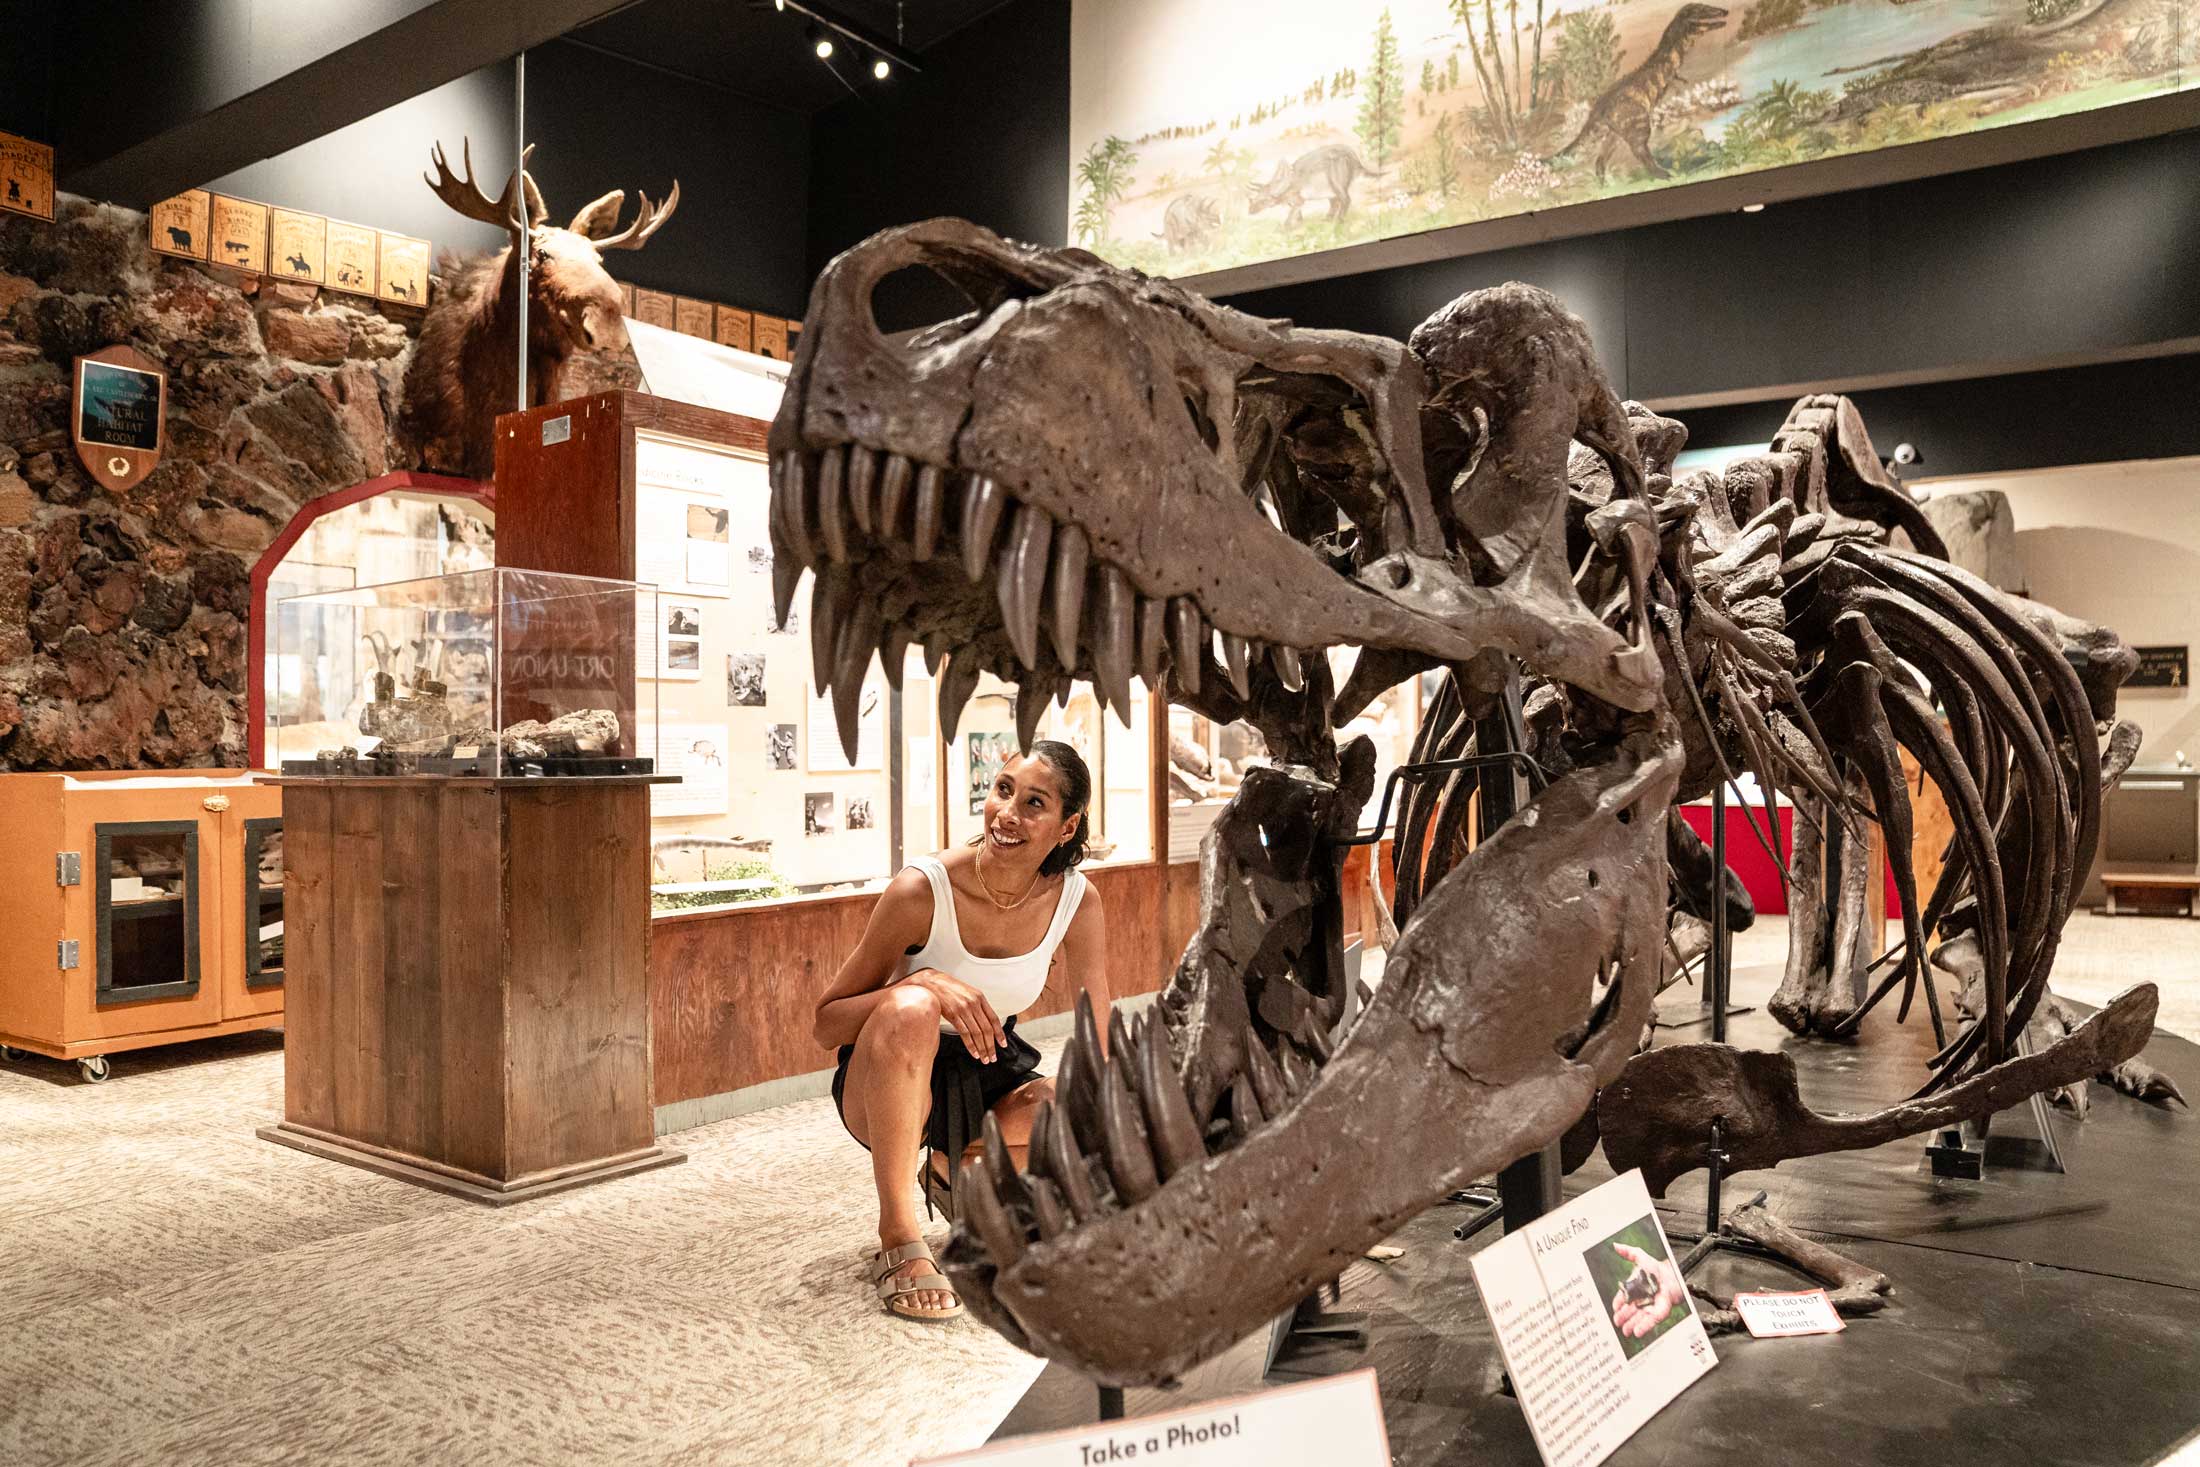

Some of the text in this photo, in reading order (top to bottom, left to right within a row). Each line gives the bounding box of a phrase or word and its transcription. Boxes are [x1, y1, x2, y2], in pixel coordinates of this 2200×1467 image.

[97, 416, 144, 433] HABITAT
[104, 430, 136, 444] ROOM
[1536, 1217, 1589, 1256] A UNIQUE FIND
[1743, 1295, 1821, 1307] PLEASE DO NOT
[1770, 1309, 1806, 1318] TOUCH
[1771, 1319, 1819, 1330] EXHIBITS
[1080, 1413, 1240, 1466] Take a Photo!
